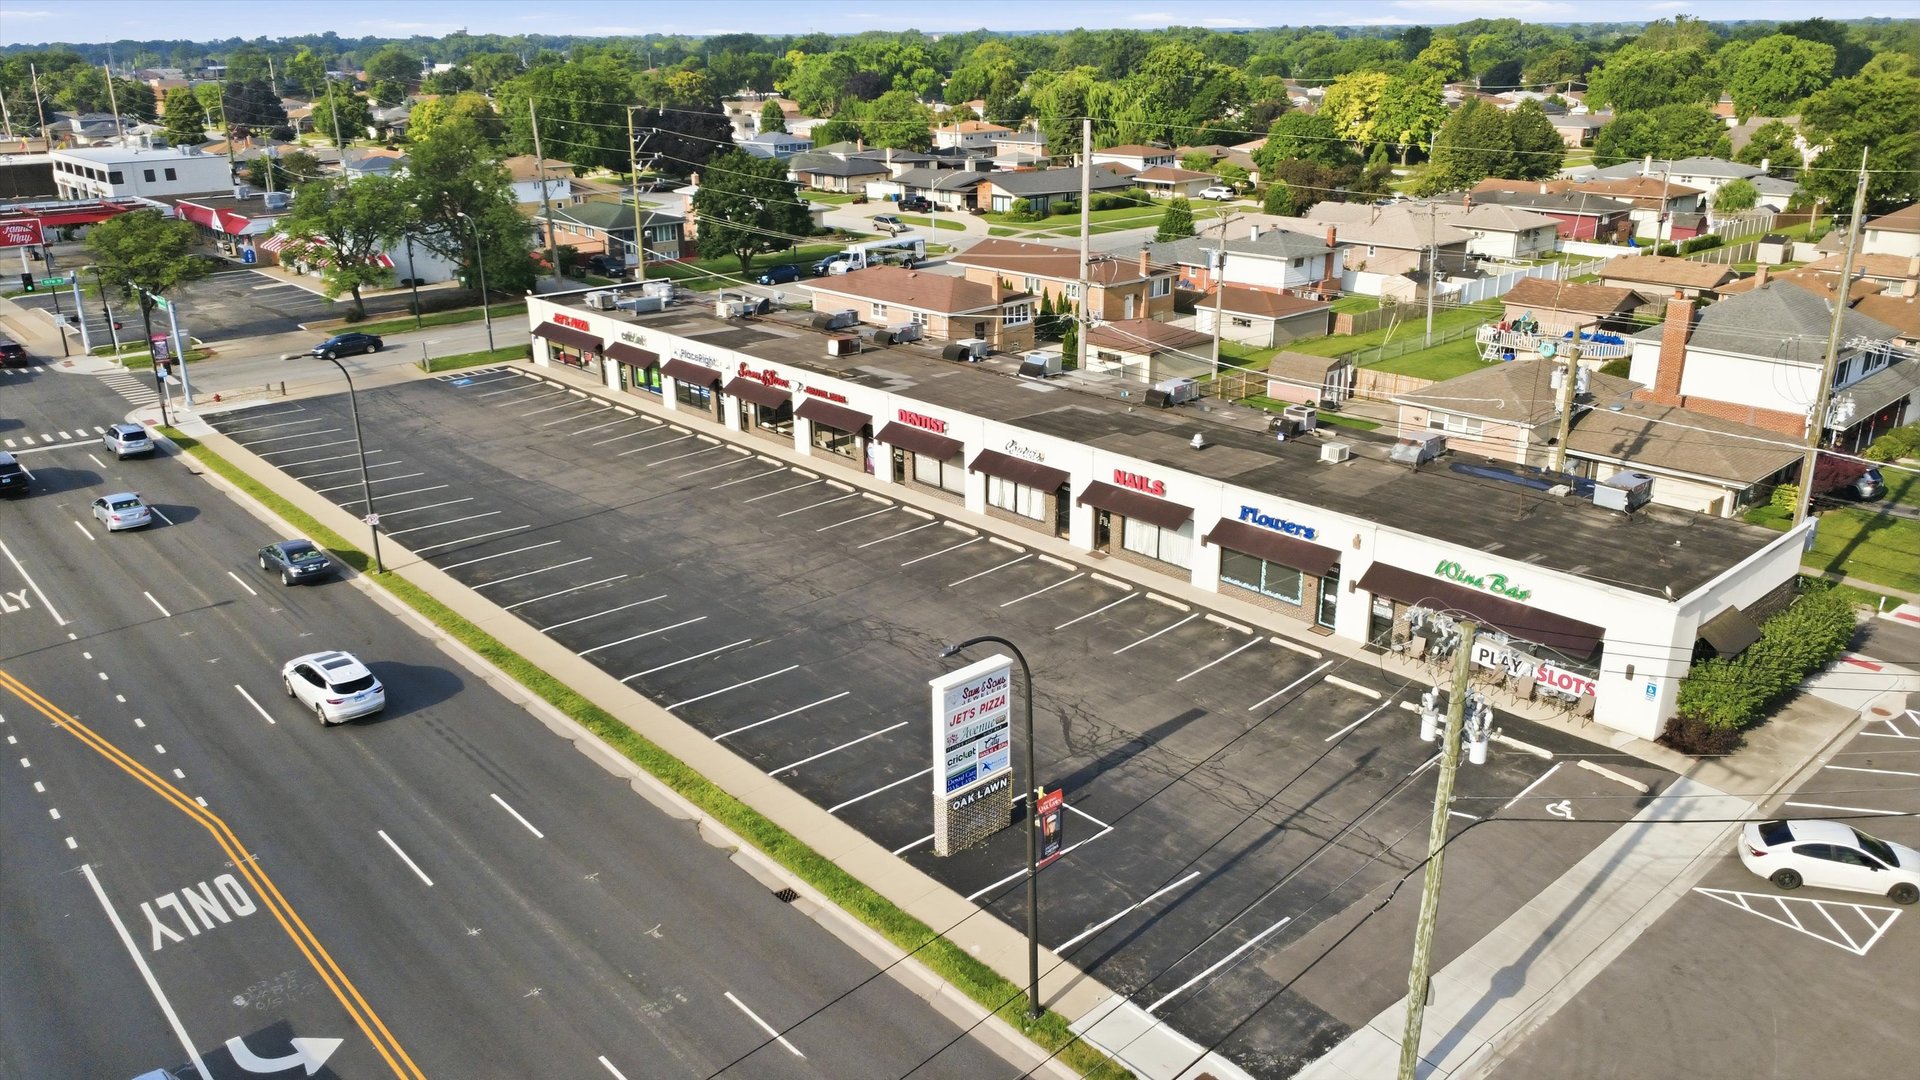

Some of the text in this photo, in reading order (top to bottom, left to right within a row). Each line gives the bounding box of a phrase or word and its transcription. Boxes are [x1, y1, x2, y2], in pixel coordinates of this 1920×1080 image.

[8, 233, 33, 243] May
[898, 408, 946, 434] DENTIST
[1113, 468, 1166, 497] NAILS
[1238, 504, 1317, 541] Flowers
[1434, 559, 1532, 601] Wine Bar
[0, 589, 31, 614] LY
[1478, 647, 1596, 697] PLAY SLOTS
[962, 676, 1006, 700] Sam & Sons
[949, 694, 1006, 727] JET'S PIZZA
[961, 719, 996, 740] Avenue
[947, 747, 976, 767] cricket
[953, 777, 1008, 810] OAK LAWN
[140, 873, 257, 951] ONLY
